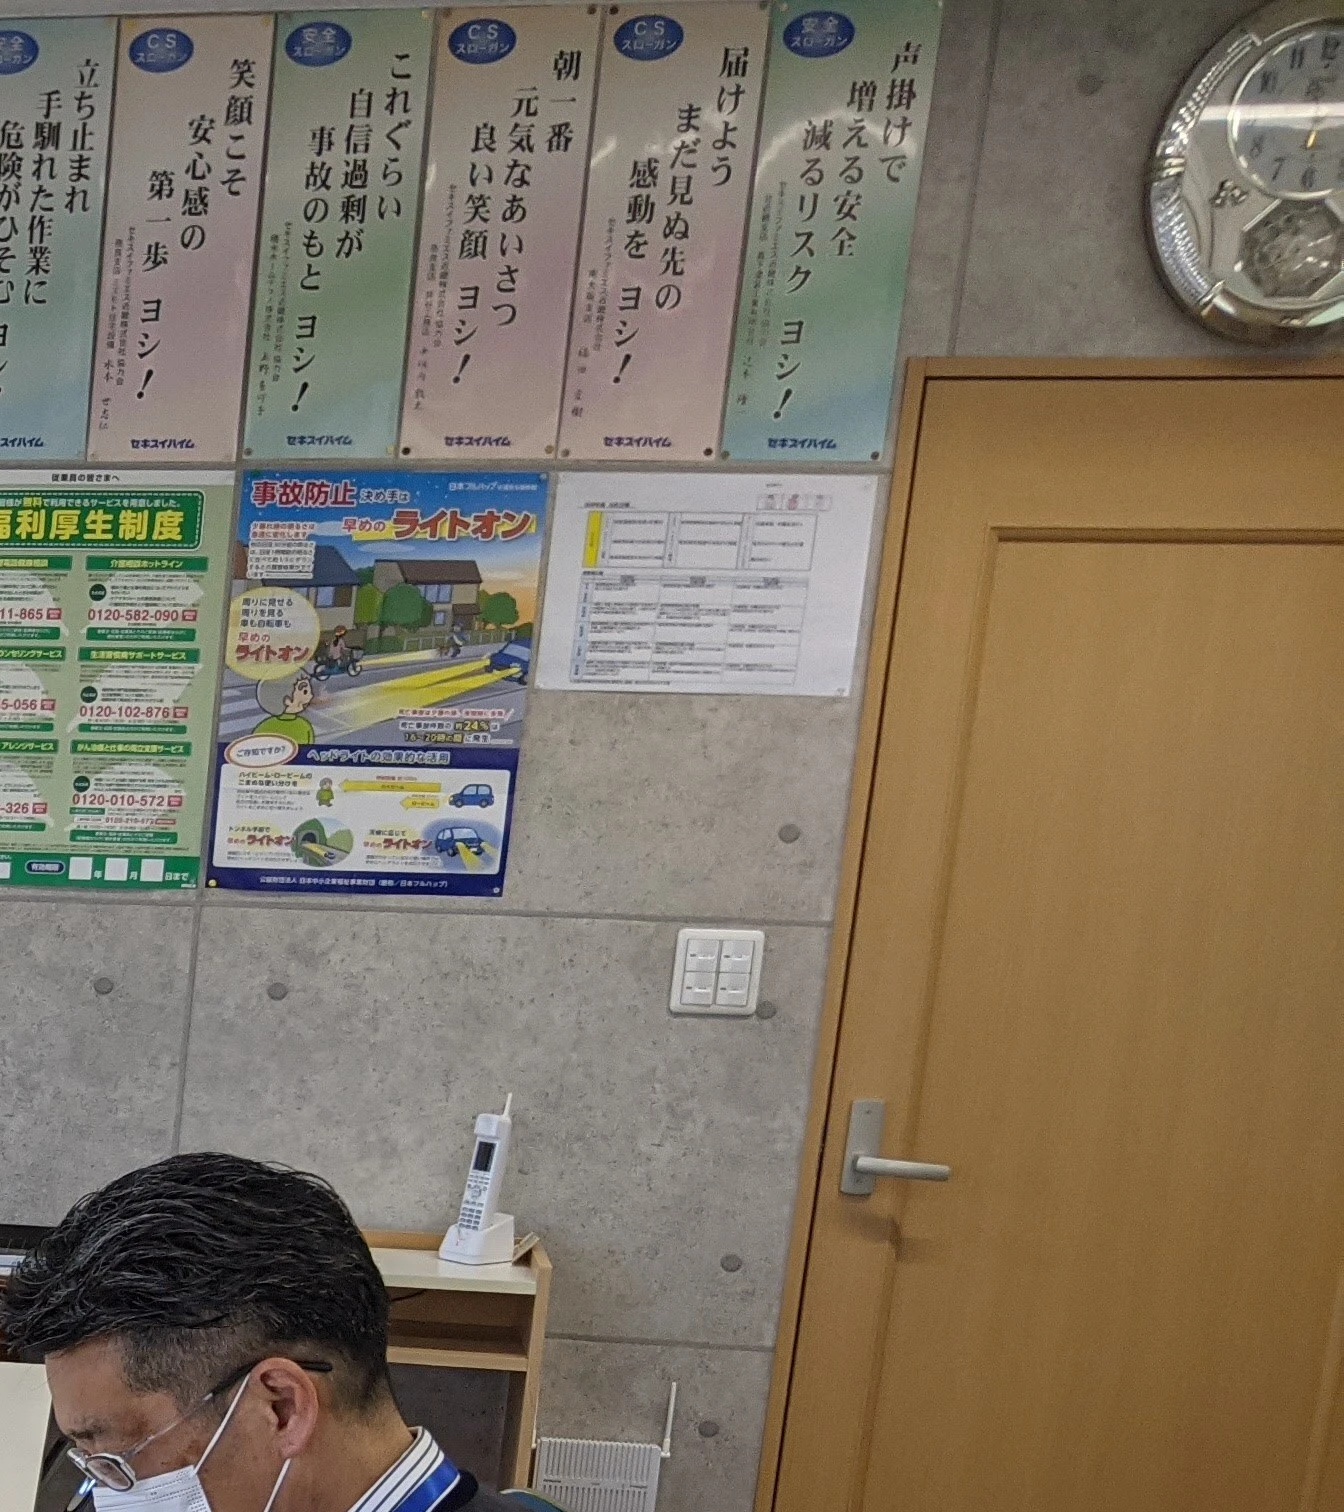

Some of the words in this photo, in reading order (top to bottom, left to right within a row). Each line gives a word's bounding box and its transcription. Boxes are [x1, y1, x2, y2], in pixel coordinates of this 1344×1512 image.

[545, 50, 582, 153] 朝一番
[711, 44, 751, 188] 届けよう
[879, 40, 924, 184] 声掛けで
[64, 58, 103, 213] 立ち止まれ
[220, 58, 257, 197] 笑顔こそ
[376, 53, 413, 220] これぐらい
[180, 114, 216, 251] 安心感の
[335, 88, 373, 258] 自信過剰が
[829, 80, 878, 258] 増える安全
[24, 90, 62, 305] 手馴れた作業に
[458, 122, 497, 261] 良い笑顔
[491, 87, 540, 328] 元気なあいさつ
[655, 102, 703, 311] まだ見ぬ先の
[785, 119, 831, 295] 減るリスク
[142, 170, 176, 272] 第一歩
[300, 126, 335, 291] 事故のもと
[624, 157, 660, 260] 感動を
[130, 438, 195, 450] セキスイハイム
[286, 434, 353, 447] セキスイハイム
[444, 436, 511, 447] セキスイハイム
[603, 436, 672, 448] セキスイハイム
[767, 437, 837, 450] セキスイハイム
[51, 473, 121, 483] 従業員の皆さまへ
[250, 480, 356, 508] 事故防止
[359, 489, 409, 504] 決め手は
[342, 517, 386, 532] 早めの
[391, 508, 533, 541] ライトオン
[88, 608, 179, 622] 0120-582-090
[241, 608, 284, 618] 周りを見る
[242, 597, 293, 606] 周りに見せる
[235, 644, 310, 662] ライトオン
[238, 632, 271, 642] 早めの
[79, 705, 170, 719] 0120-102-876
[307, 750, 451, 764] ヘッドライトの効果的な活用
[72, 793, 165, 807] 0120-010-572
[247, 835, 296, 847] ライトオン
[383, 838, 432, 850] ライトオン
